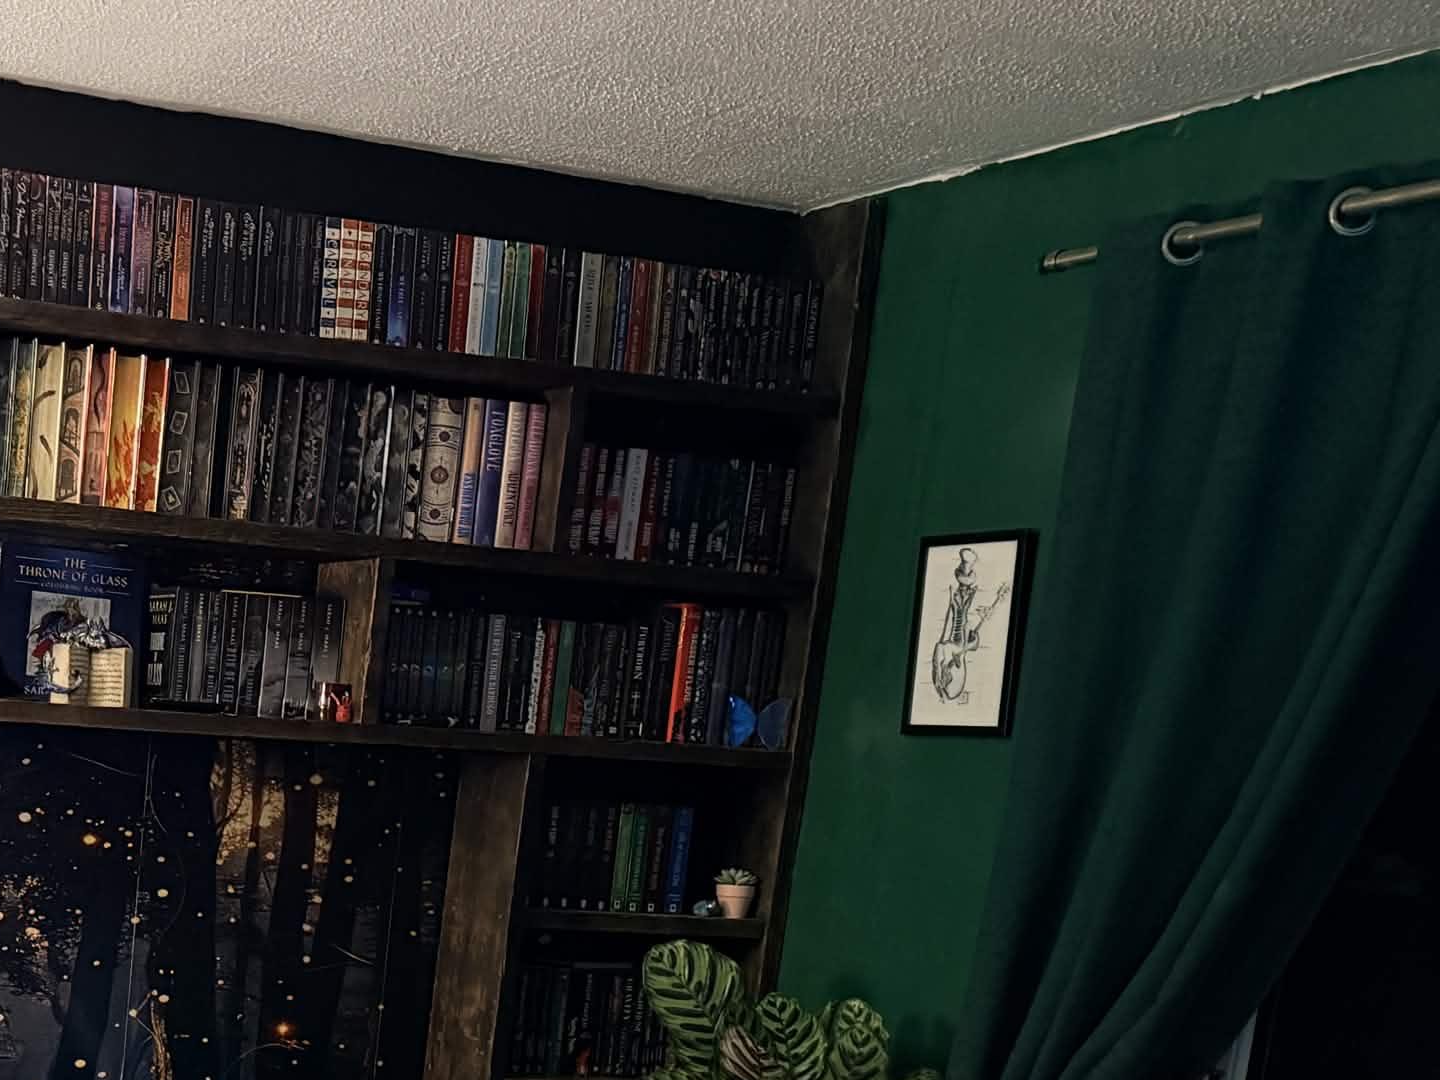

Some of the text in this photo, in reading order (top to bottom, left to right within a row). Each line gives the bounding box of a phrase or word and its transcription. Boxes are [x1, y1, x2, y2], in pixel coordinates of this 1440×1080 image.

[323, 239, 340, 308] CARAVAL
[339, 240, 355, 299] FINALE
[356, 232, 373, 320] LEGENDARY
[485, 410, 505, 473] FOXGLOVE
[17, 564, 129, 589] THRONE OF GLASS
[63, 557, 88, 570] THE
